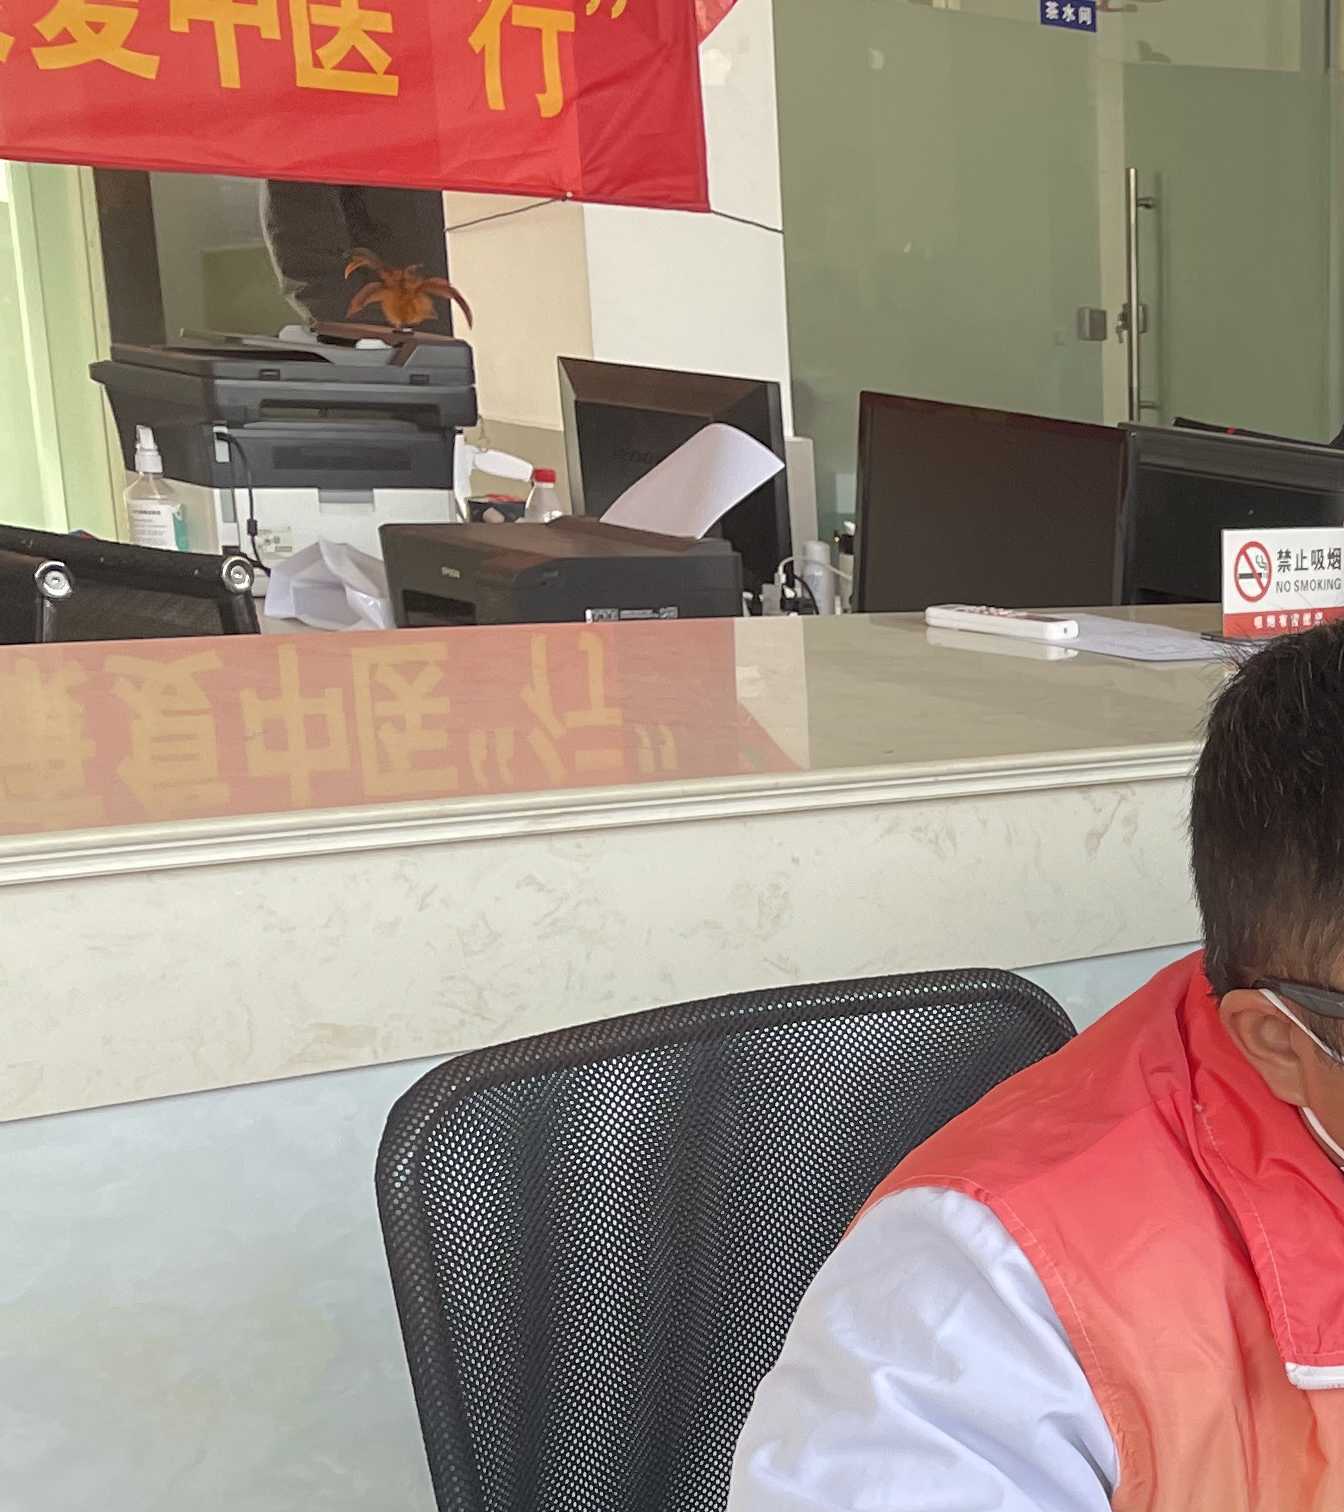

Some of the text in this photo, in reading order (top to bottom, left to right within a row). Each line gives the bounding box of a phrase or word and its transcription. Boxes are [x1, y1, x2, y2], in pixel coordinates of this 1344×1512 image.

[1044, 0, 1093, 25] 茶水间
[1276, 547, 1342, 574] 禁止吸烟
[1276, 577, 1342, 593] NO SMOKING
